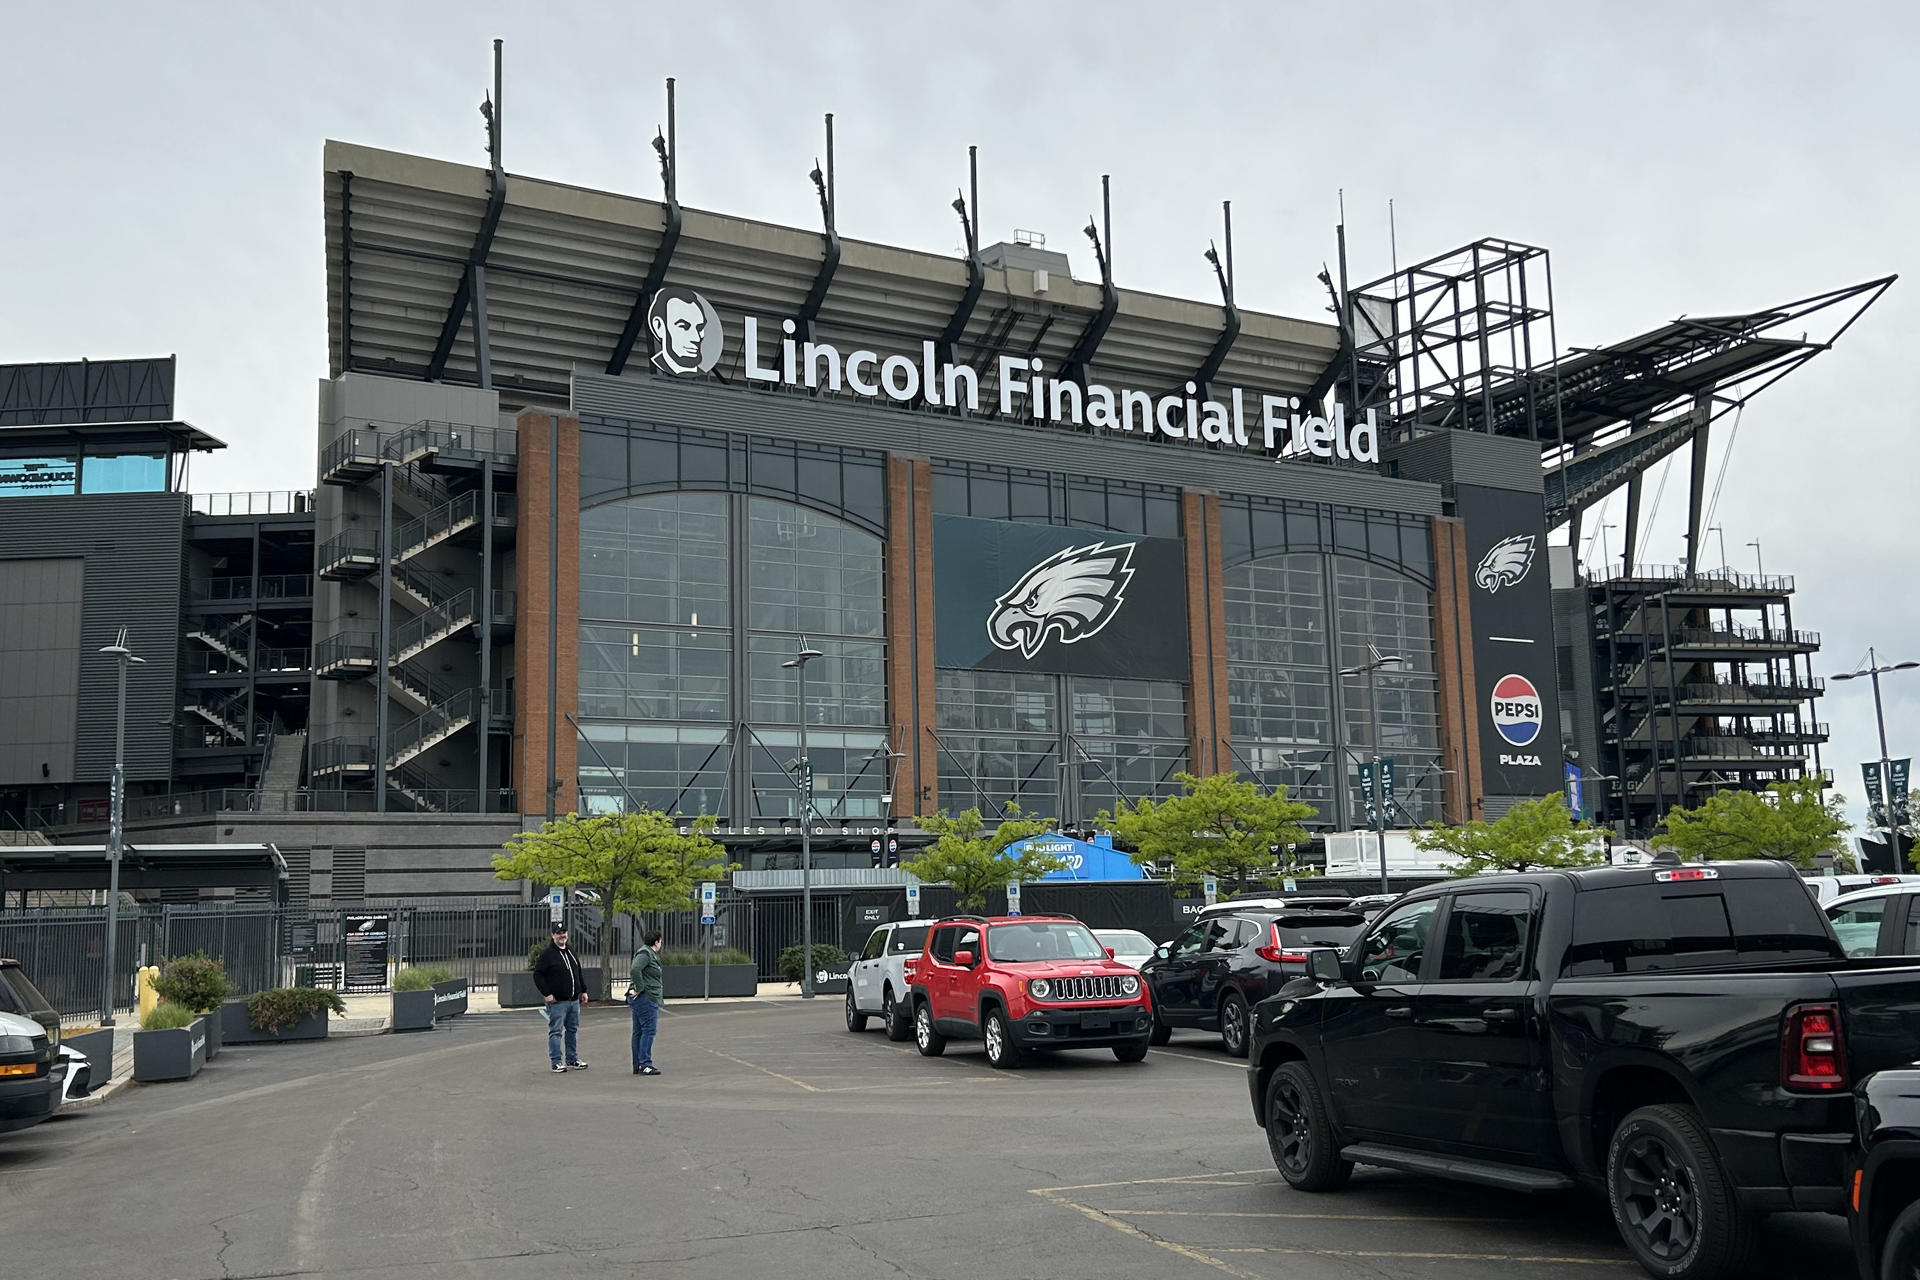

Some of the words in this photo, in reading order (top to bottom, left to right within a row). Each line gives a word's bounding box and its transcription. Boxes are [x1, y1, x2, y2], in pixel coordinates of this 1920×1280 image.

[744, 316, 979, 410] Lincoln
[999, 355, 1249, 447] Financial
[1262, 394, 1379, 464] Field
[1494, 701, 1539, 718] PEPSI
[1499, 754, 1542, 766] PLAZA
[785, 826, 824, 835] PO
[842, 826, 897, 835] SHOP
[1045, 844, 1073, 852] LIGHT
[829, 972, 848, 980] Linco
